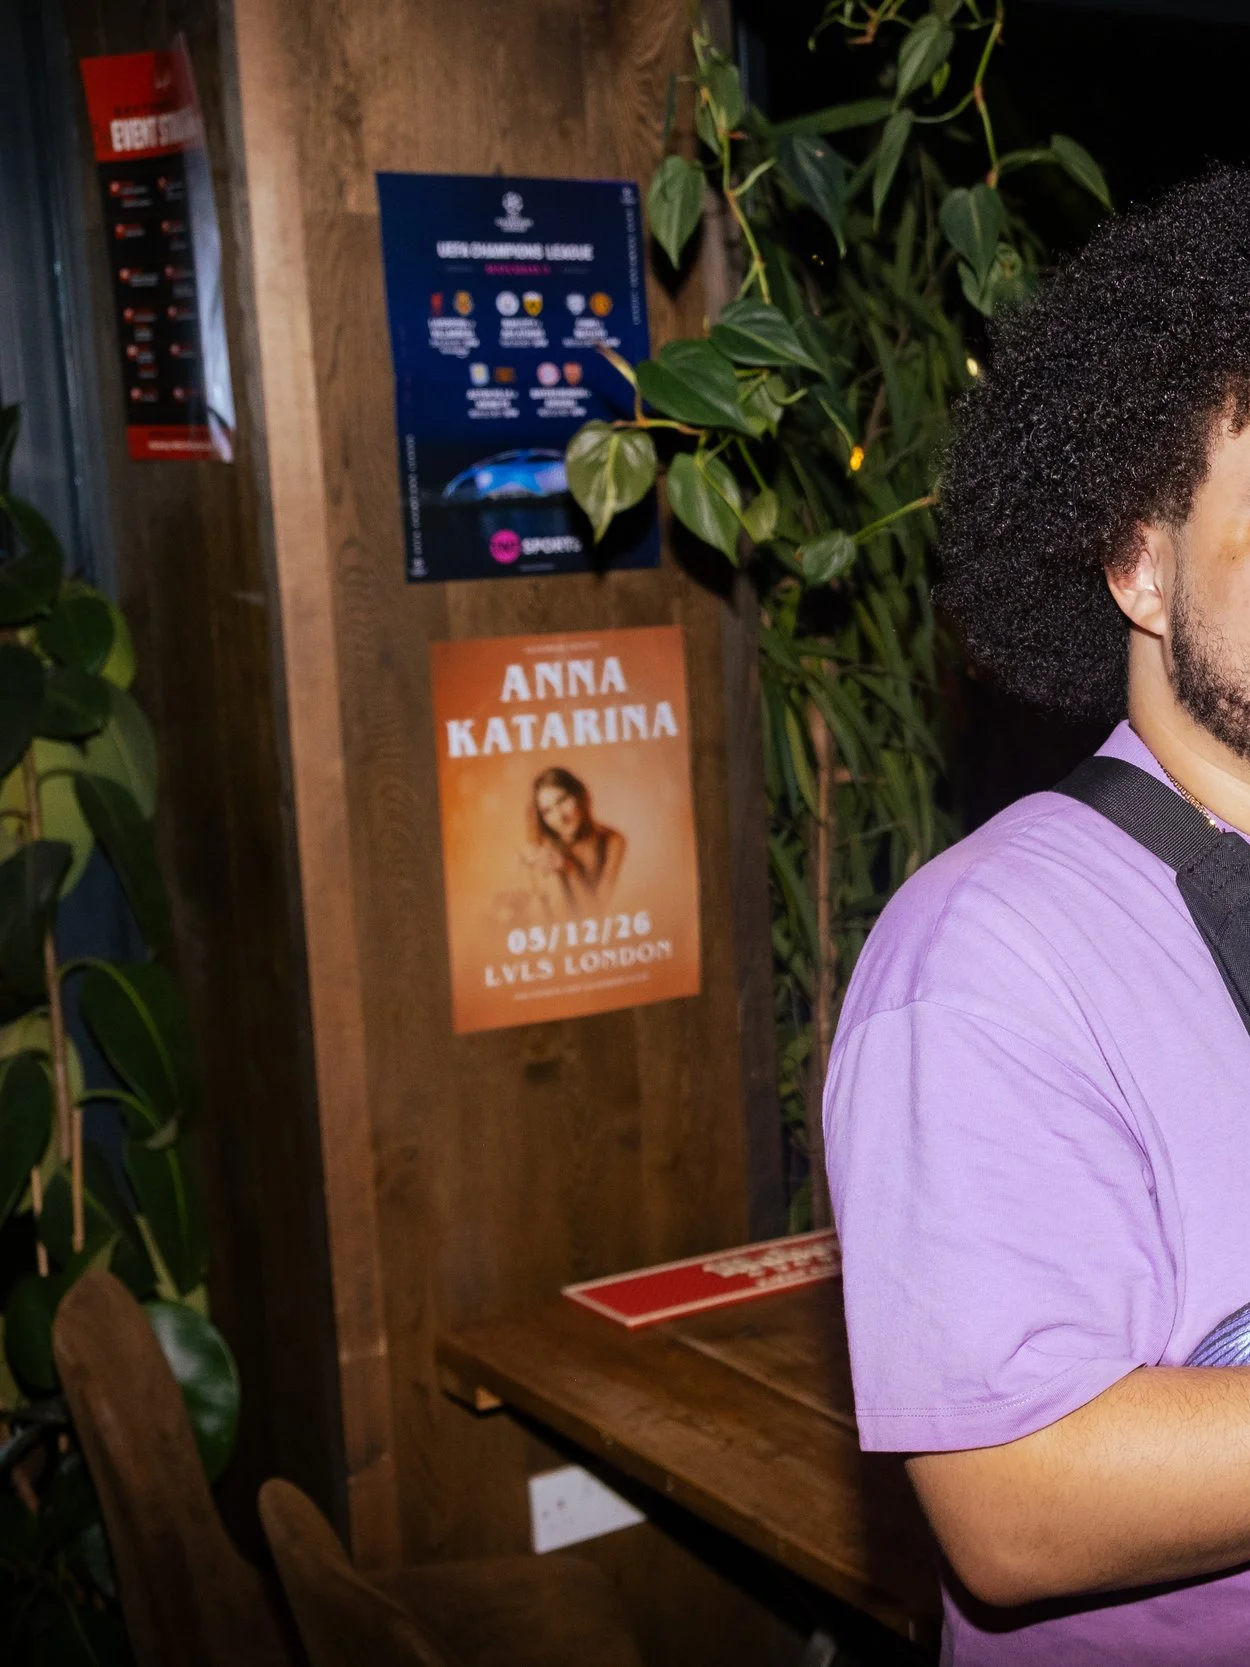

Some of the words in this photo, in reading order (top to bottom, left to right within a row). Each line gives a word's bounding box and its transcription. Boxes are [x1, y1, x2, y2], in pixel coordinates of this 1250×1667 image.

[436, 240, 470, 259] UEFA
[470, 241, 544, 260] CHAMPIONS
[545, 243, 595, 262] LEAGUE
[501, 656, 627, 702] ANNA
[446, 701, 678, 758] KATARINA
[507, 911, 652, 955] 05/12/26
[484, 957, 555, 988] LVLS
[564, 940, 673, 975] LONDON
